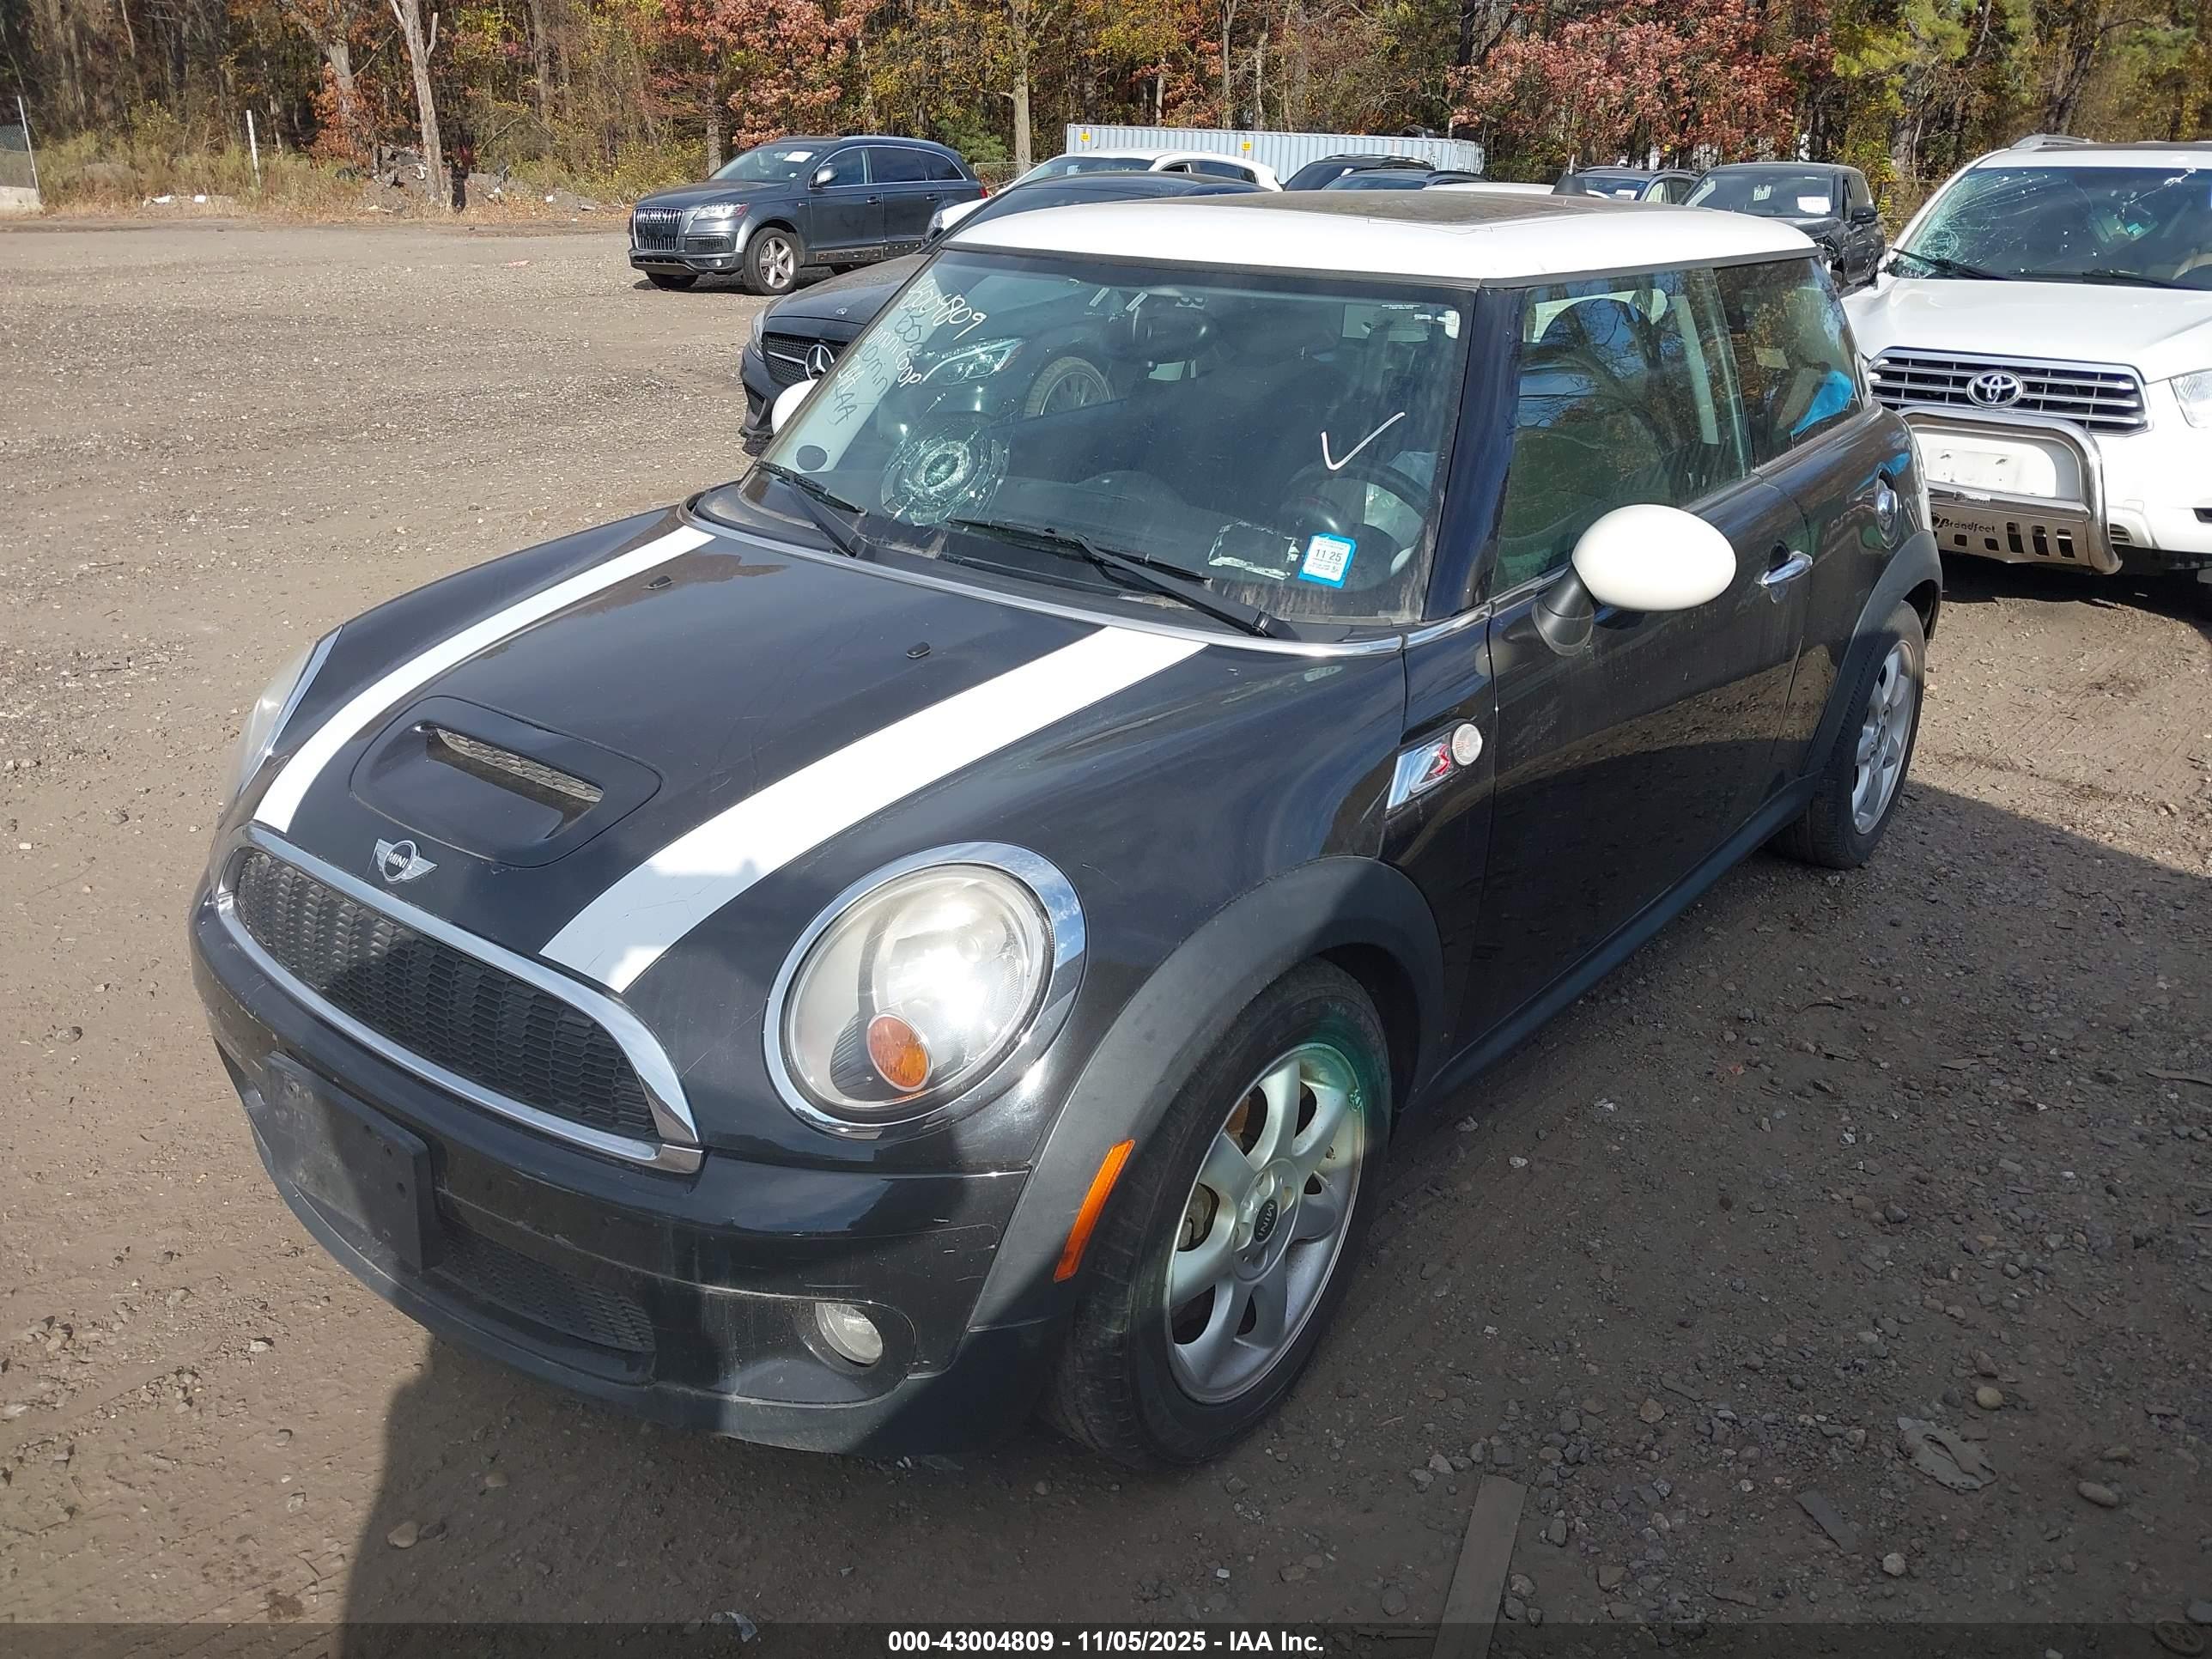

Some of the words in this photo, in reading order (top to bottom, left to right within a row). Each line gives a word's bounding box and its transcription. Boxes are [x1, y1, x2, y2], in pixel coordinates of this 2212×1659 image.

[1328, 551, 1343, 562] 25
[387, 851, 409, 869] MINI
[1258, 1203, 1275, 1237] MINI
